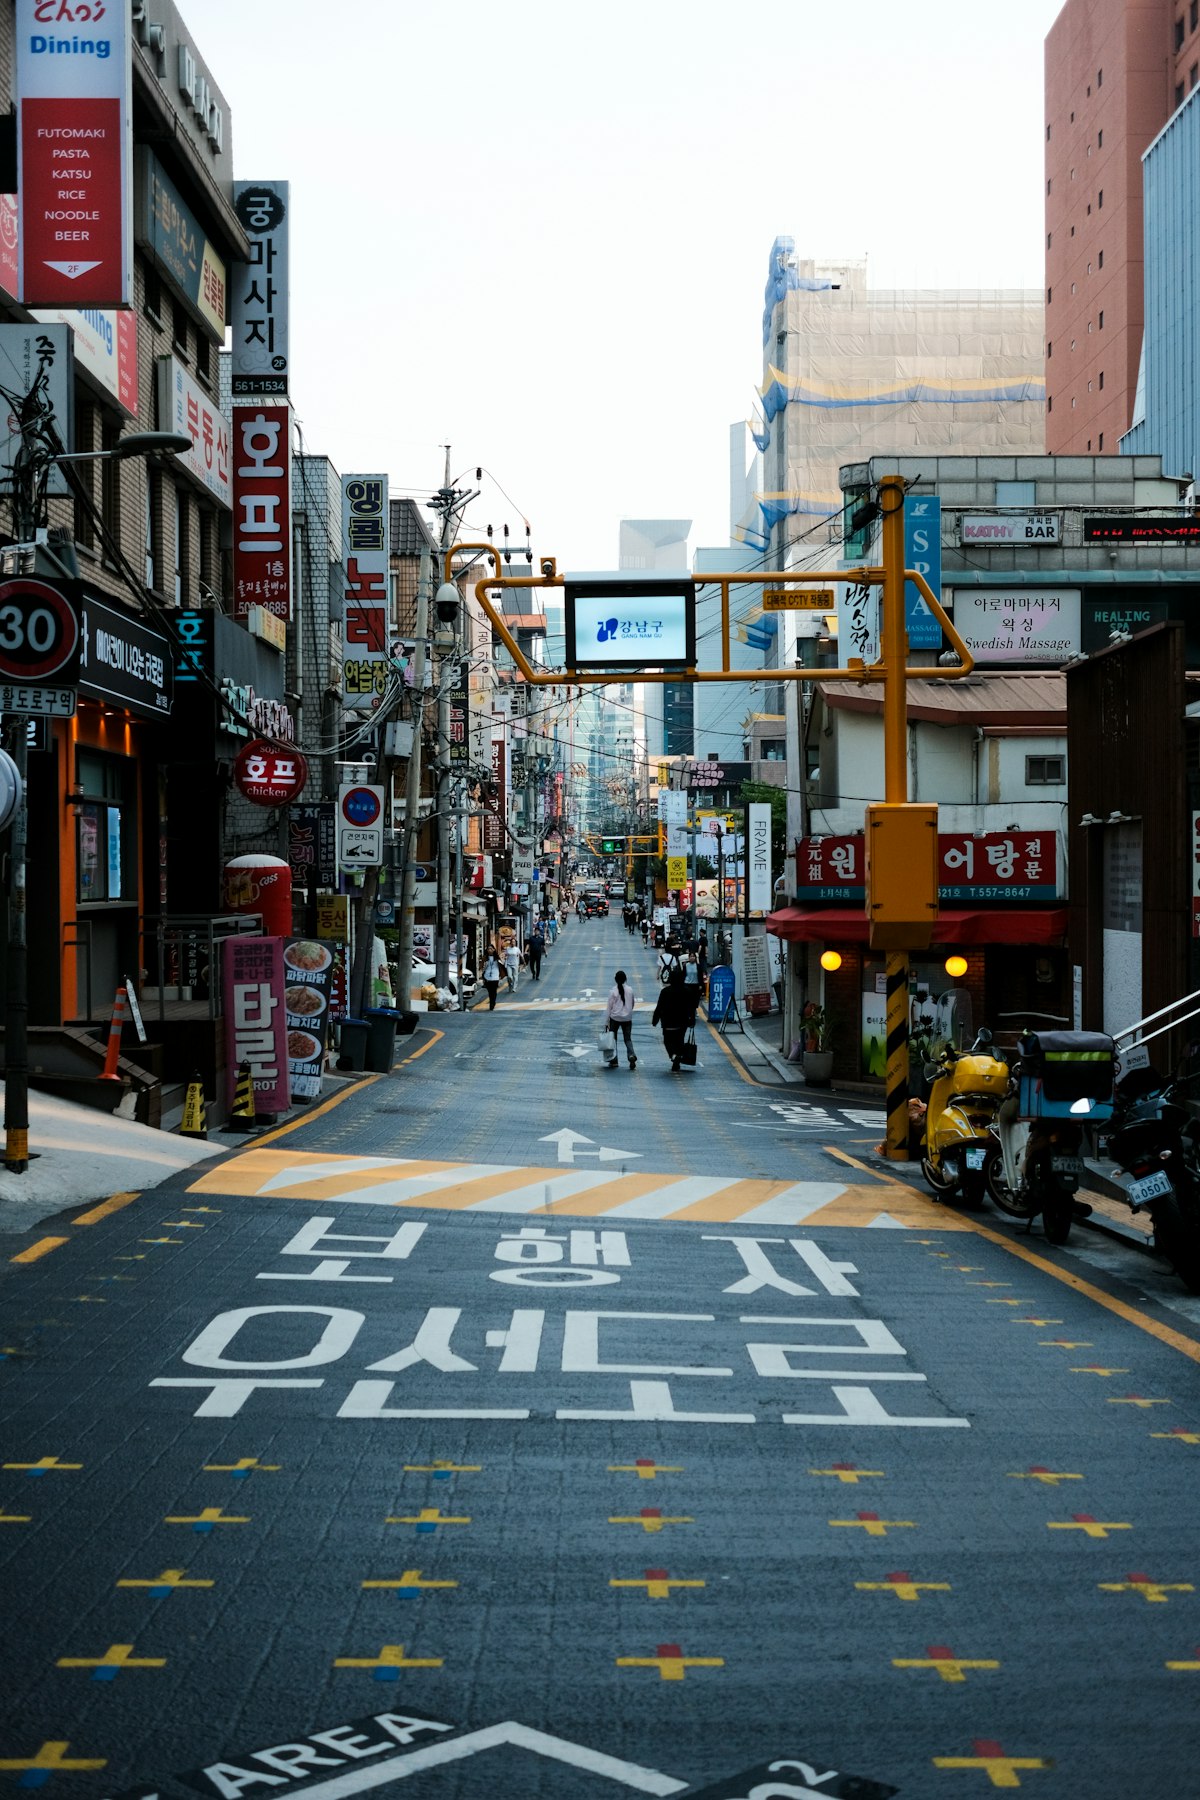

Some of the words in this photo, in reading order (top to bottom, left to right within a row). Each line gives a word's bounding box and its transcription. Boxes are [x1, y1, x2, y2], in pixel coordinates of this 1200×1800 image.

[30, 36, 110, 58] Dining
[37, 129, 105, 138] FUTOMAKI
[52, 150, 90, 158] PASTA
[52, 170, 92, 179] KATSU
[58, 190, 86, 199] RICE
[45, 210, 100, 220] NOODLE
[246, 196, 274, 228] 궁
[55, 231, 90, 241] BEER
[67, 265, 79, 273] 2F
[244, 239, 277, 353] 마사지
[234, 381, 286, 391] 561-1534
[188, 392, 228, 484] 부동산
[237, 414, 285, 552] 호프
[345, 480, 384, 551] 앵콜
[1025, 526, 1055, 538] BAR
[265, 560, 285, 577] 1층
[237, 579, 287, 598] 을지로골뱅이
[345, 558, 386, 653] 노래
[766, 594, 786, 606] 다목적
[788, 595, 809, 606] CCTV
[810, 594, 830, 606] 작동중
[975, 598, 1060, 611] 아로마마사지
[1094, 611, 1151, 622] HEALING
[1, 606, 56, 650] 30
[620, 620, 664, 633] 강남구
[1110, 622, 1130, 632] SPA
[965, 637, 1013, 650] Swedish
[1018, 637, 1071, 651] Massage
[344, 660, 388, 695] 연습장
[242, 755, 296, 785] 호프
[247, 786, 288, 797] chicken
[347, 833, 375, 841] 견인지역
[754, 821, 767, 871] FRAME
[808, 844, 824, 881] 元祖
[1024, 838, 1043, 880] 전문
[321, 873, 334, 883] B1
[970, 887, 1031, 898] T.557-8647
[233, 983, 278, 1078] 타로
[253, 1080, 278, 1091] ROT
[185, 1092, 195, 1129] 주차금지
[1141, 1180, 1167, 1198] 0501
[256, 1216, 860, 1297] 보행자
[149, 1305, 972, 1427] 우선도로
[202, 1712, 456, 1799] AREA
